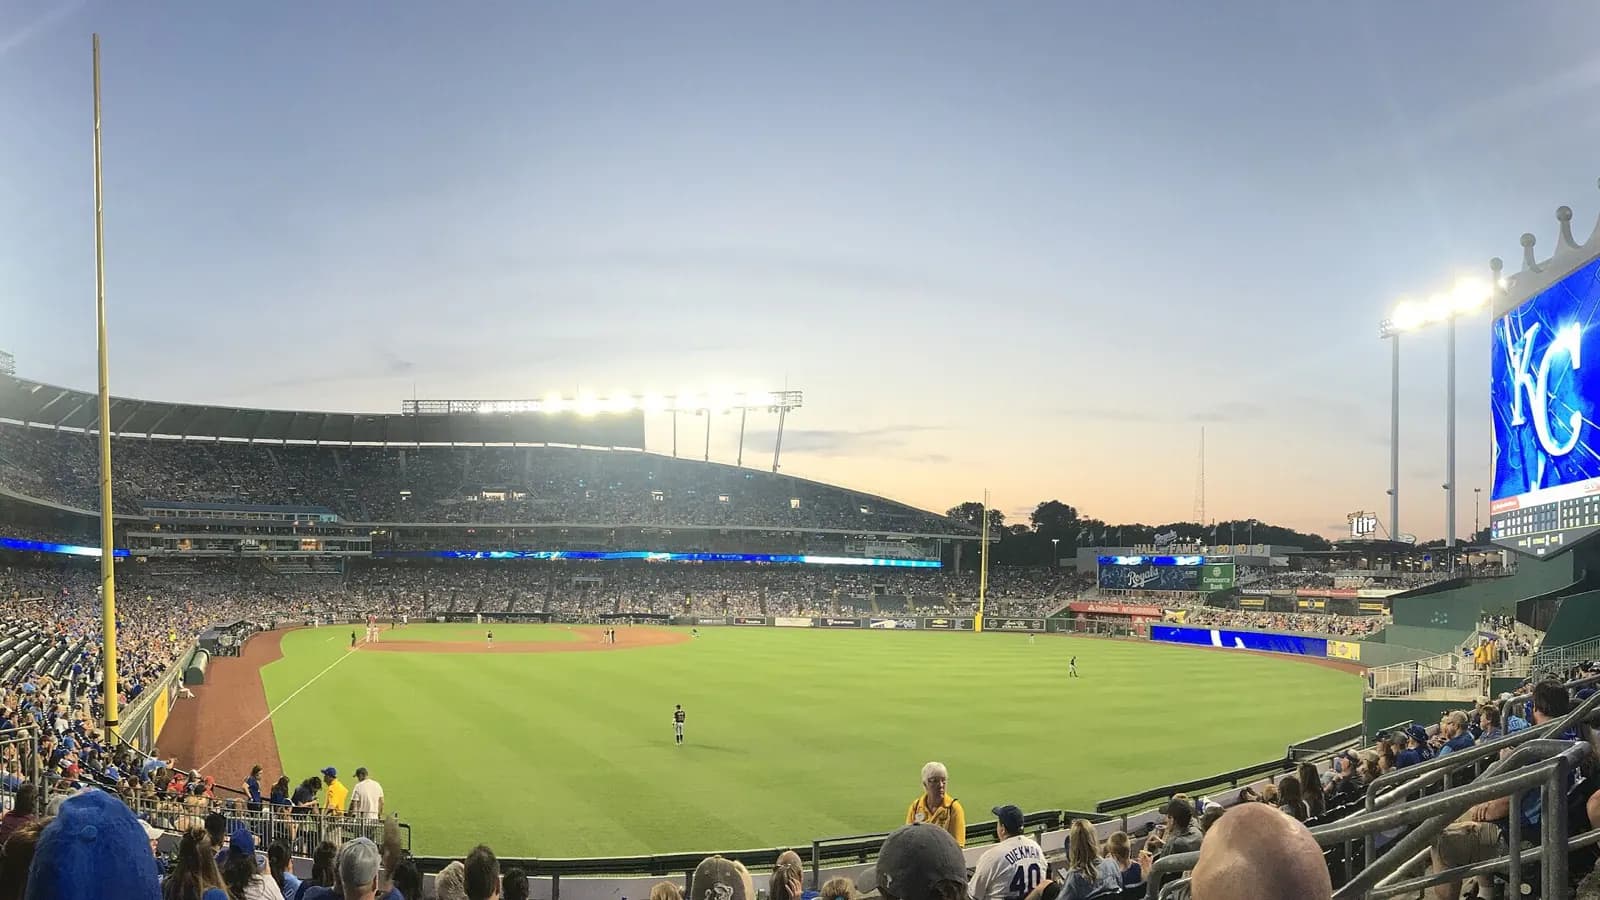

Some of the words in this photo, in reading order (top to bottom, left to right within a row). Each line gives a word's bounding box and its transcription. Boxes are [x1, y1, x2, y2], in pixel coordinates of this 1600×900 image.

[1352, 517, 1377, 537] Lite
[1134, 543, 1161, 554] HALL
[1169, 543, 1201, 554] FAME
[1127, 565, 1159, 588] Royals
[1009, 863, 1041, 897] 40
